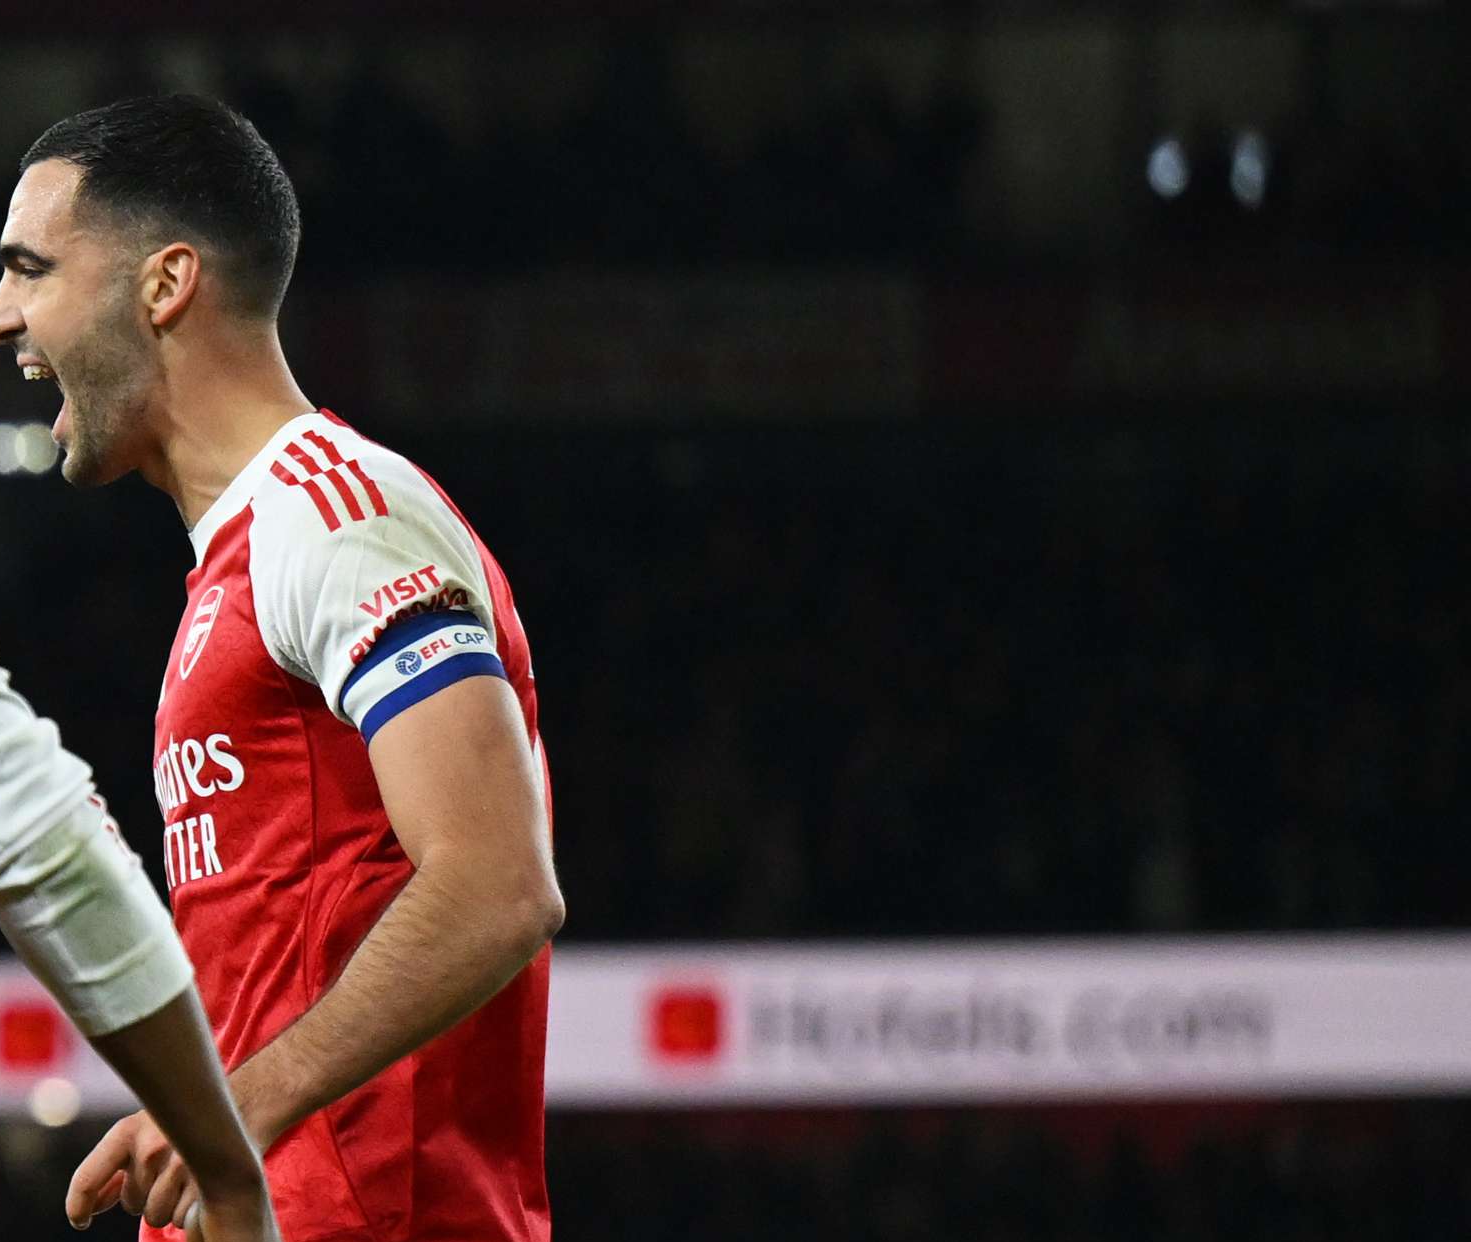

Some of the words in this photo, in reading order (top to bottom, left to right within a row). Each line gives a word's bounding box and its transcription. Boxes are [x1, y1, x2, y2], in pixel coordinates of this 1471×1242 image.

[358, 563, 442, 619] VISIT
[419, 638, 452, 660] EFL
[453, 632, 486, 645] CAP
[163, 812, 224, 892] TTER
